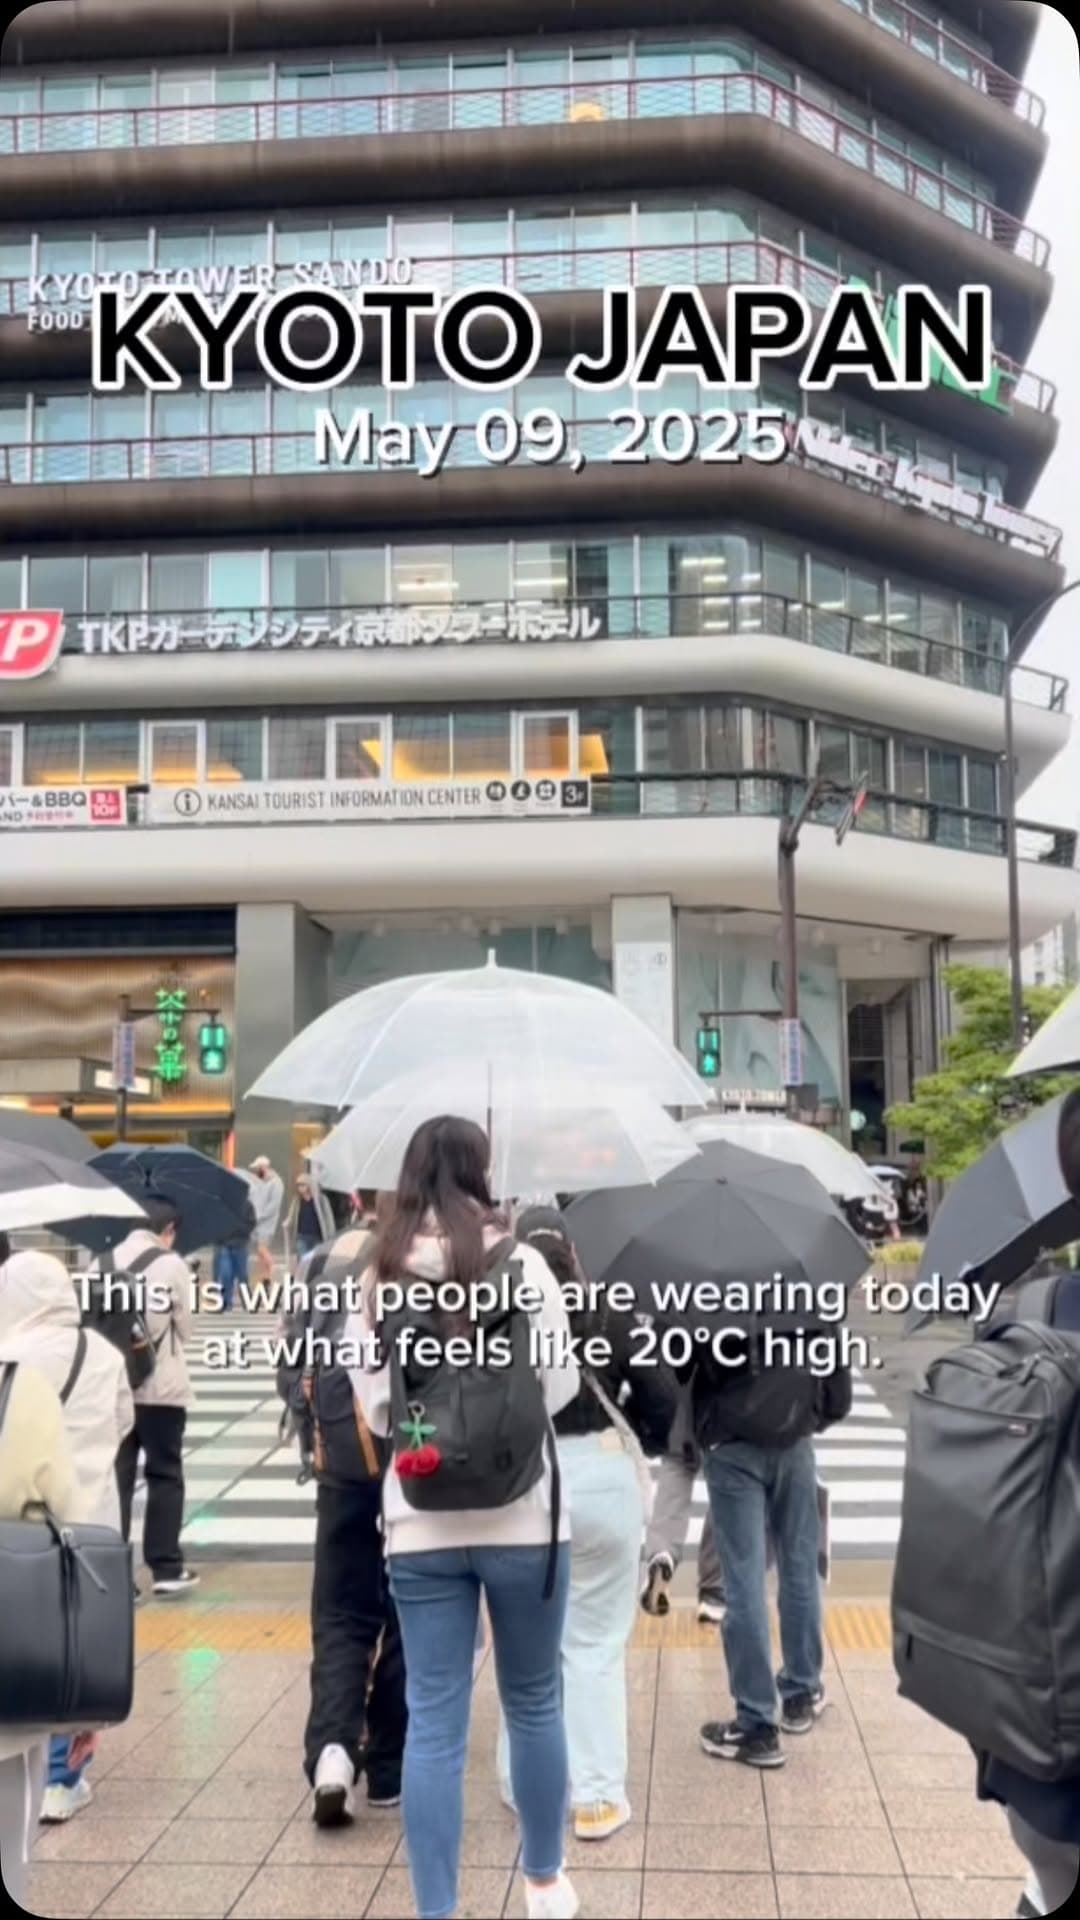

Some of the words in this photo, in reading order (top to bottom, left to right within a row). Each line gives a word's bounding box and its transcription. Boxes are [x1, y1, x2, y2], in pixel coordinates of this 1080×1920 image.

[28, 271, 139, 302] KYOTO
[152, 263, 275, 297] TOWER
[294, 258, 412, 286] SANDO
[27, 310, 83, 331] FOOD
[0, 617, 49, 662] P
[208, 791, 259, 811] KANSAI
[264, 790, 326, 809] TOURIST
[330, 787, 424, 808] INFORMATION
[427, 786, 482, 806] CENTER
